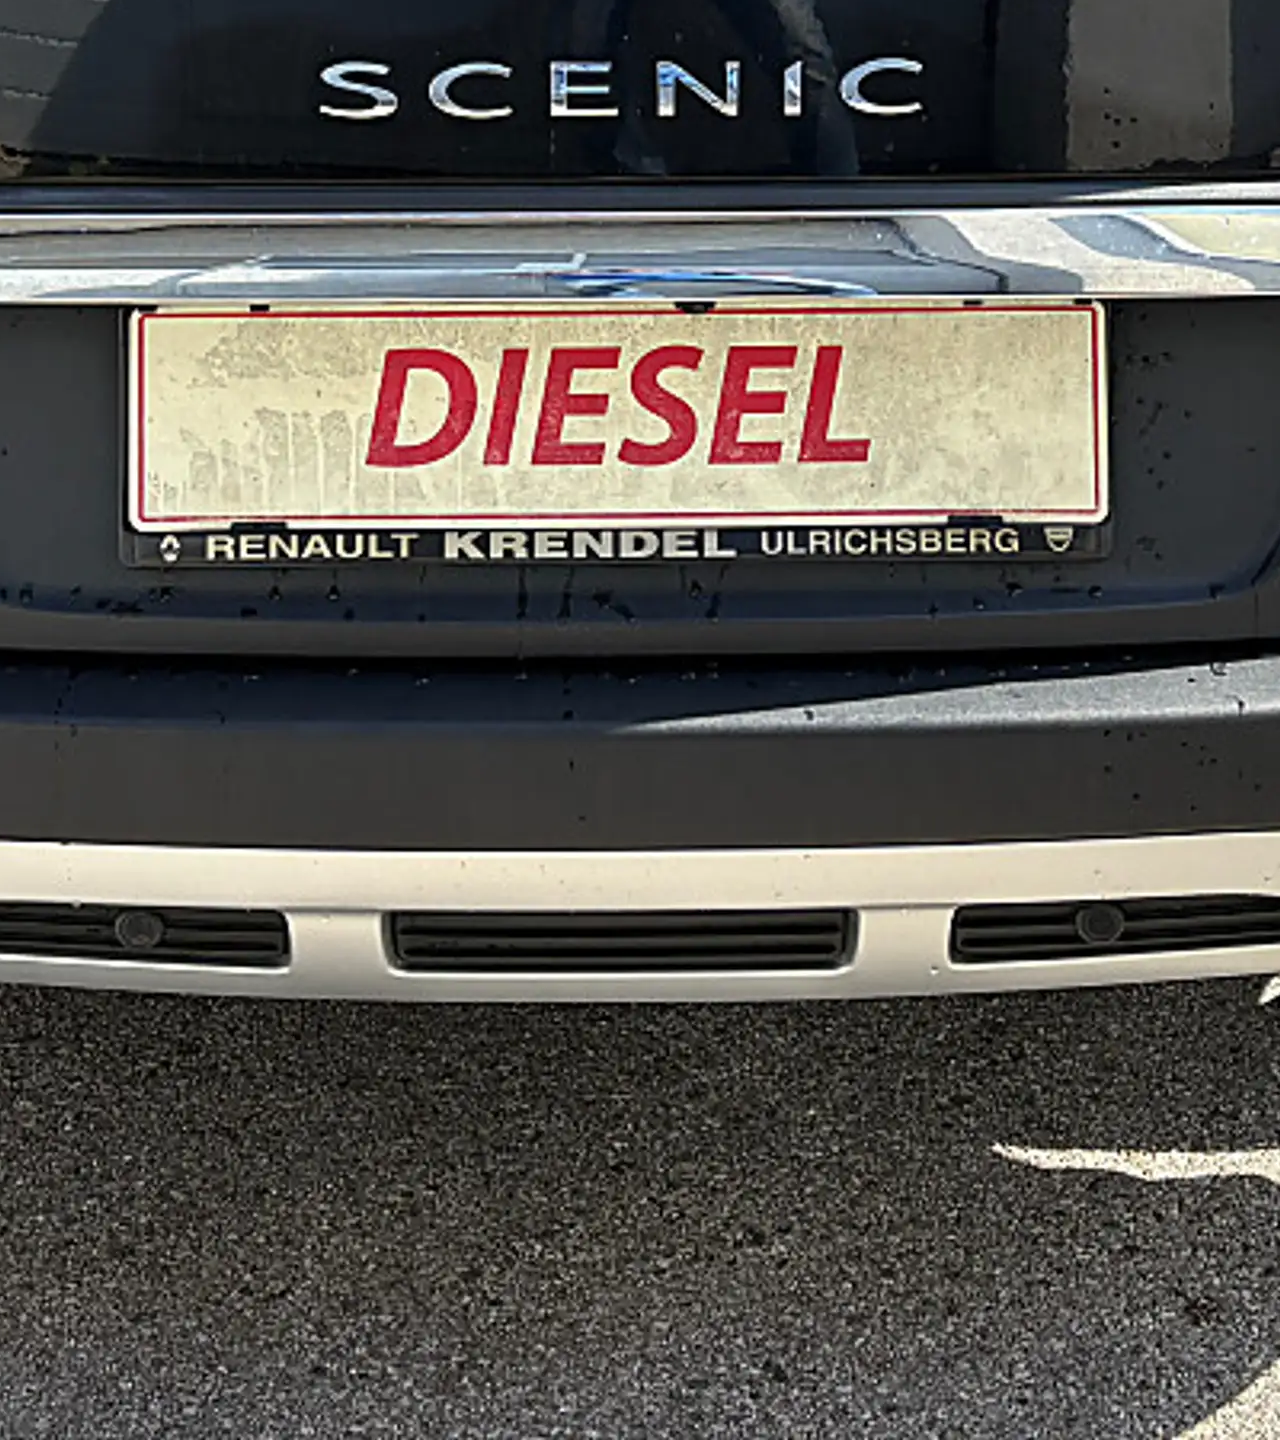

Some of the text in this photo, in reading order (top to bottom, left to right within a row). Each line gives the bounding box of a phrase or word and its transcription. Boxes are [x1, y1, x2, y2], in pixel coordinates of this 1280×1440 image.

[319, 56, 923, 120] SCENIC
[365, 344, 870, 467] DIESEL
[205, 527, 1021, 560] RENAULT KRENDEL ULRICHSBERG
